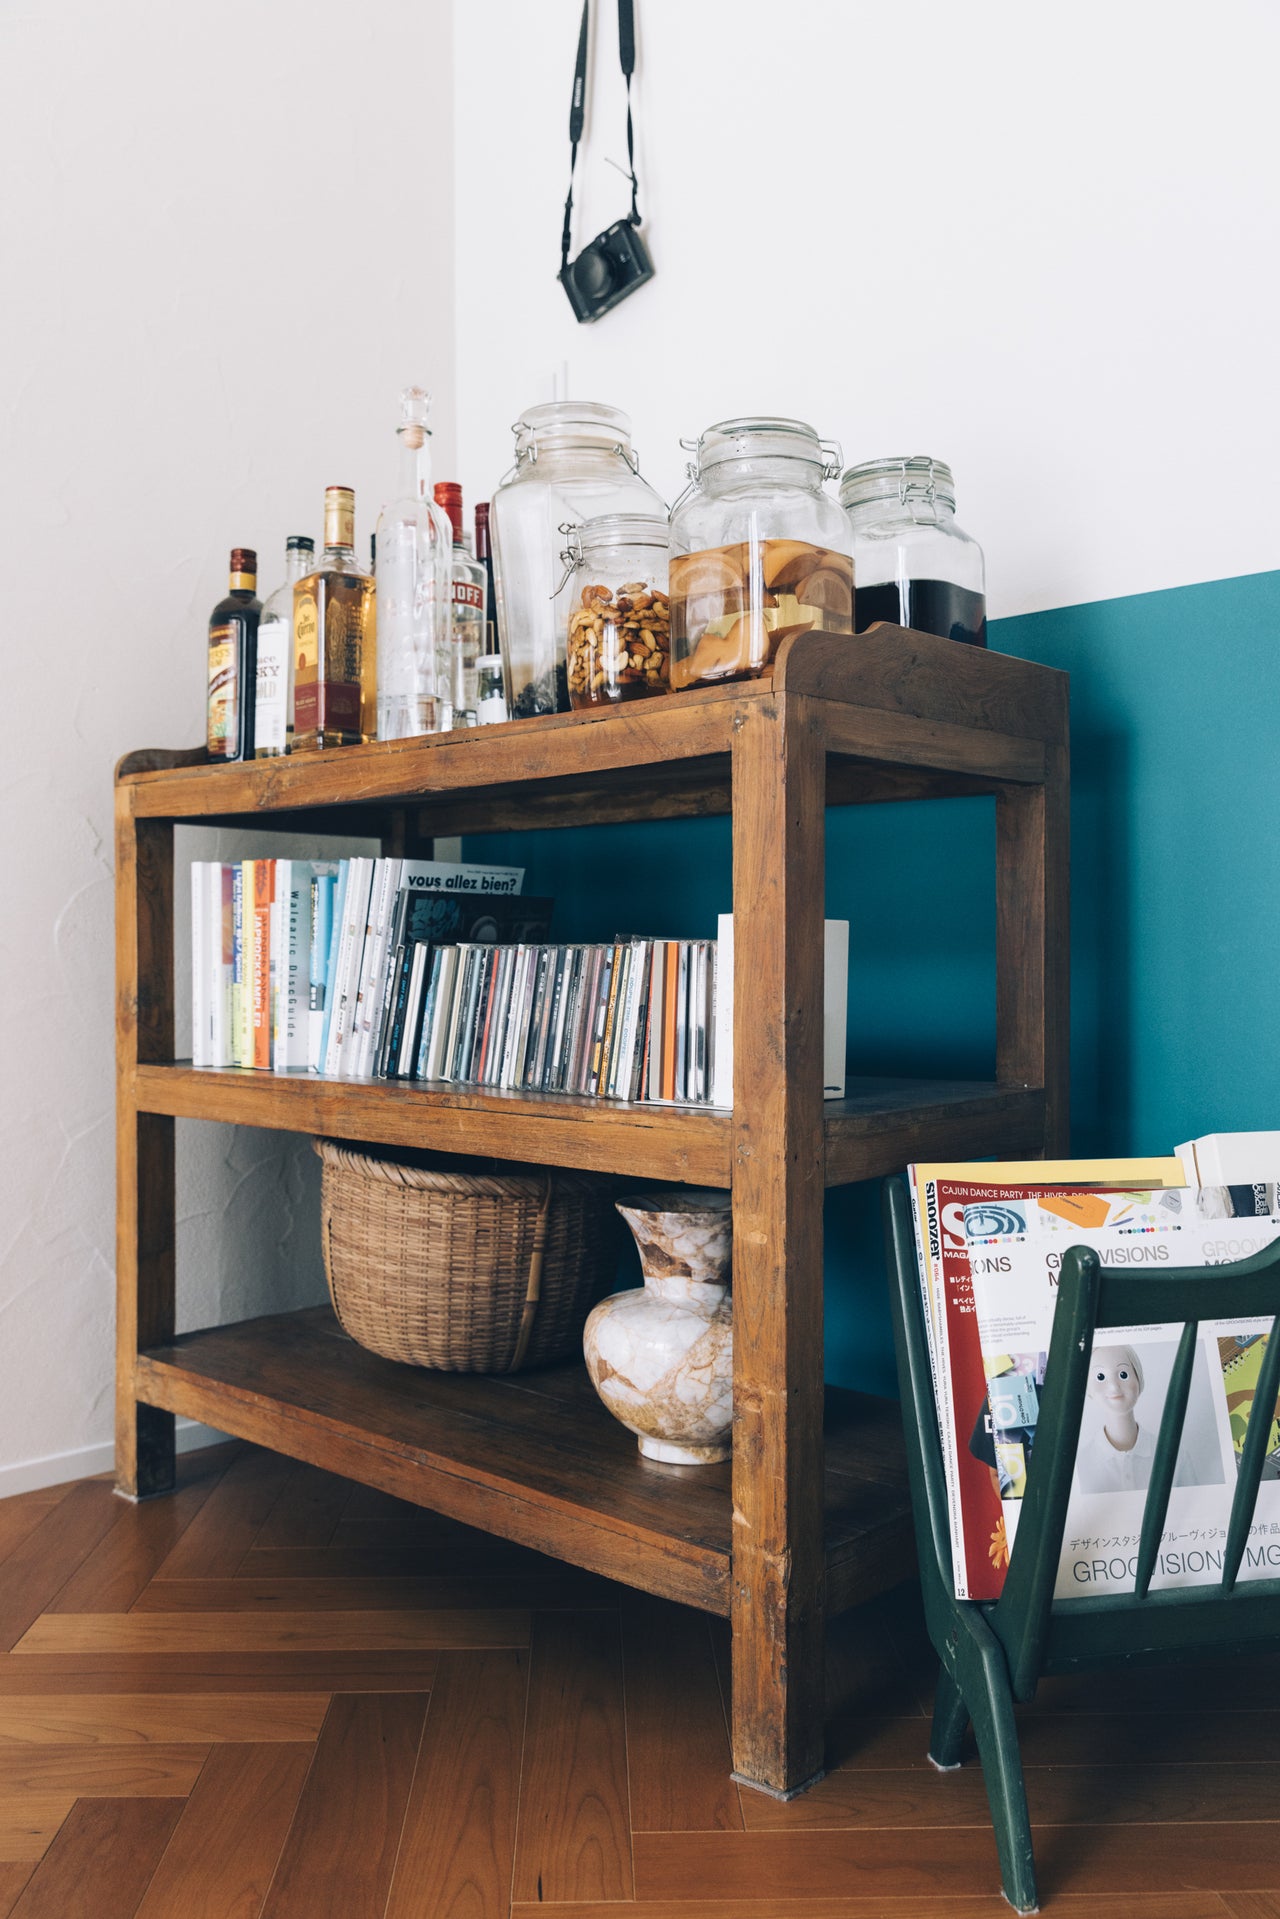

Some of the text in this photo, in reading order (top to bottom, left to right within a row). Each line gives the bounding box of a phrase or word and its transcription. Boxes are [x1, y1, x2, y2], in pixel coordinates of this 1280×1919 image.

[408, 874, 517, 891] vous allez bien?
[289, 890, 299, 955] Walearic
[942, 1186, 968, 1196] CAJUN
[970, 1187, 998, 1198] DANCE
[1000, 1190, 1024, 1199] PARTY
[926, 1181, 940, 1261] snoozer
[1046, 1244, 1170, 1269] GVISIONS
[957, 1588, 966, 1597] 12
